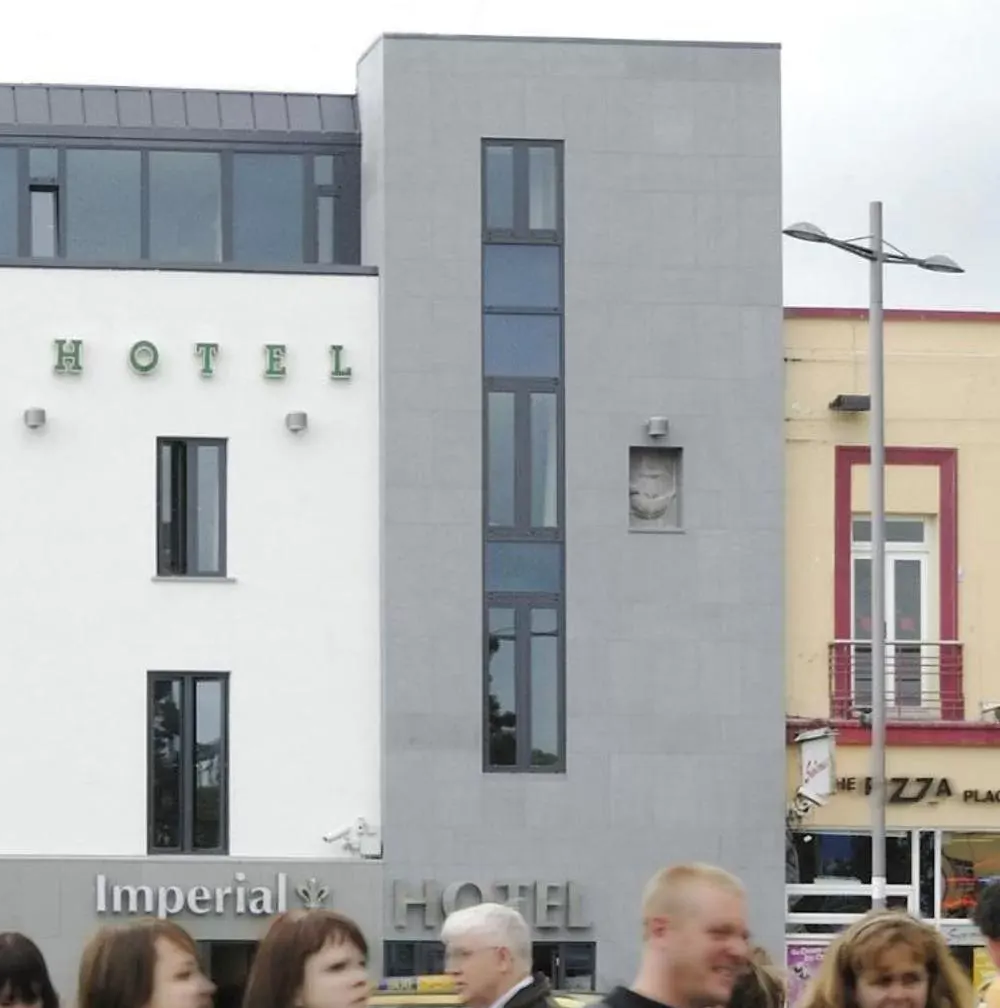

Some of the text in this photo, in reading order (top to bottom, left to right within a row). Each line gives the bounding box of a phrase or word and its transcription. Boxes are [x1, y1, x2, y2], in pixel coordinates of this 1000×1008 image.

[52, 338, 353, 381] HOTEL
[835, 776, 857, 791] HE
[864, 776, 953, 804] PZZA
[96, 872, 288, 920] Imperial
